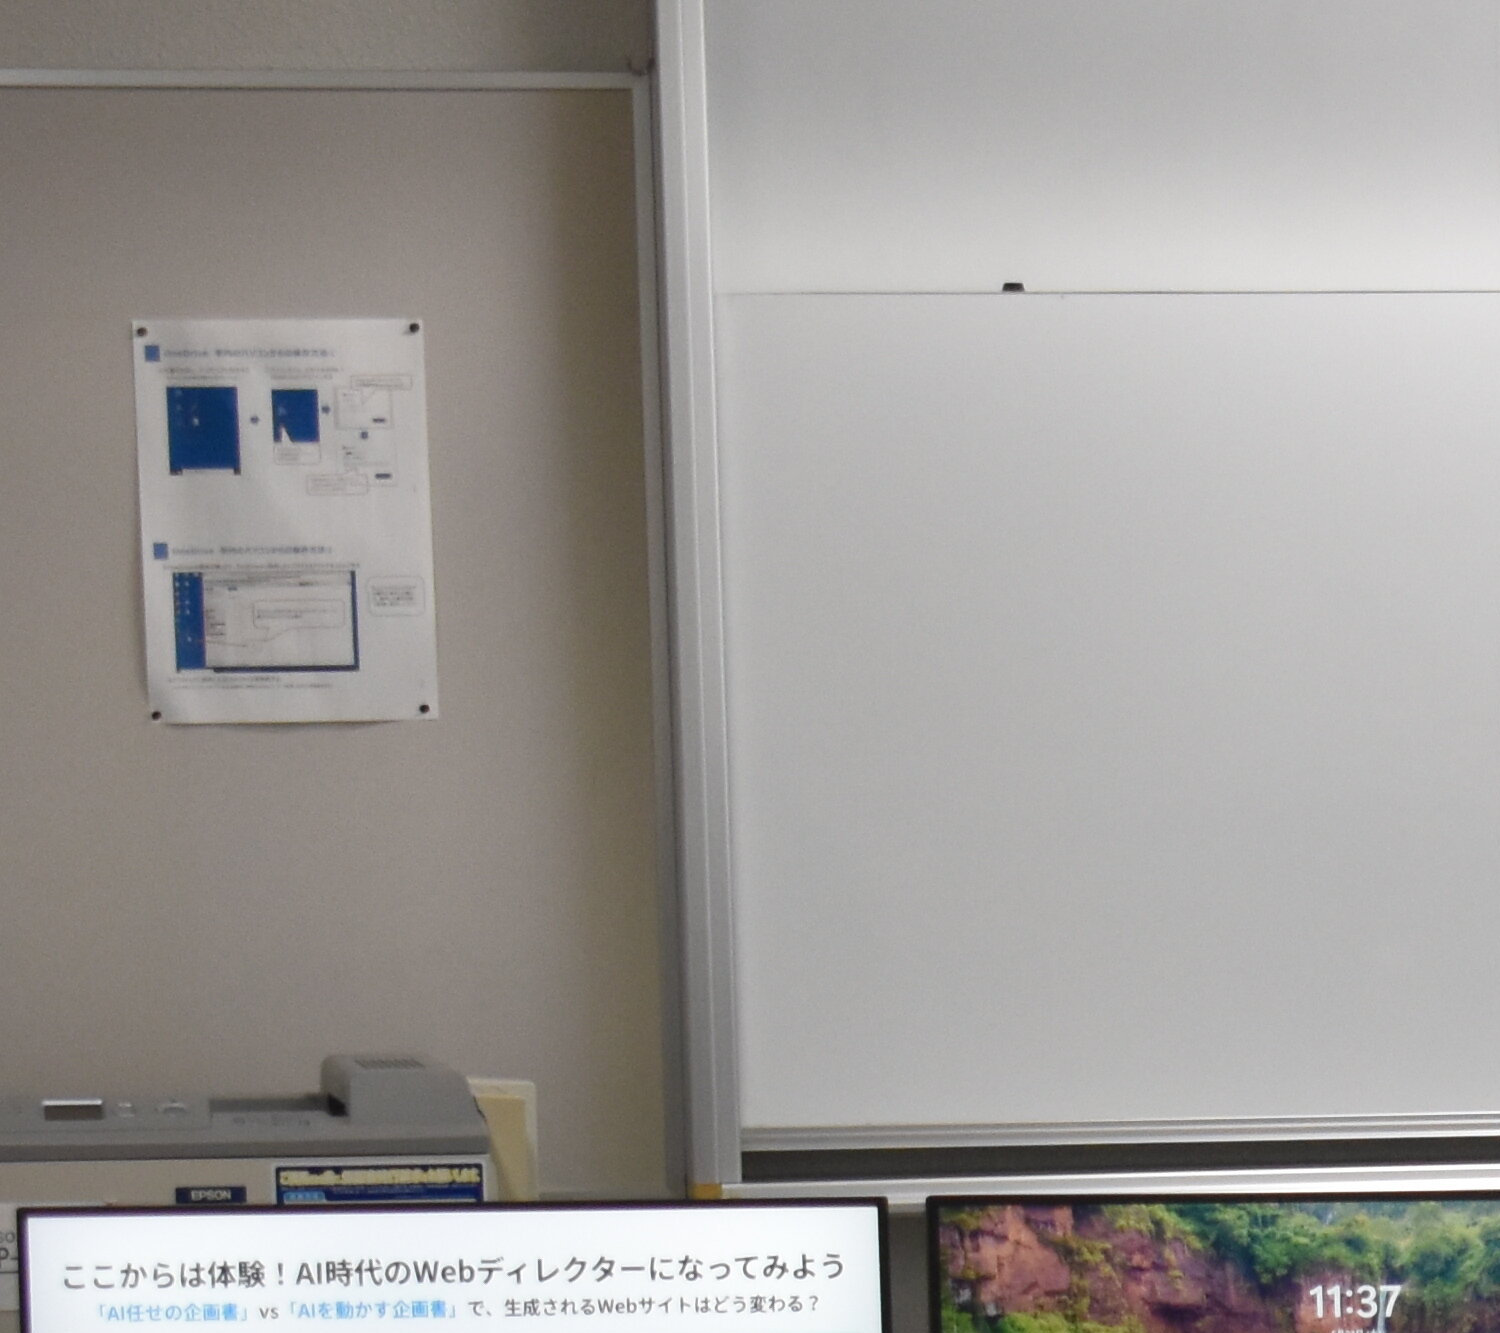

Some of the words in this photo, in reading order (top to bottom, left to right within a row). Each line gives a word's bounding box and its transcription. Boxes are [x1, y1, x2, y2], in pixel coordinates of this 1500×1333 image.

[191, 1189, 231, 1200] EPSON
[63, 1252, 844, 1289] ここからは体験！AI時代のWebディレクターになってみよう
[259, 1306, 280, 1320] vs
[1309, 1284, 1403, 1319] 11:37
